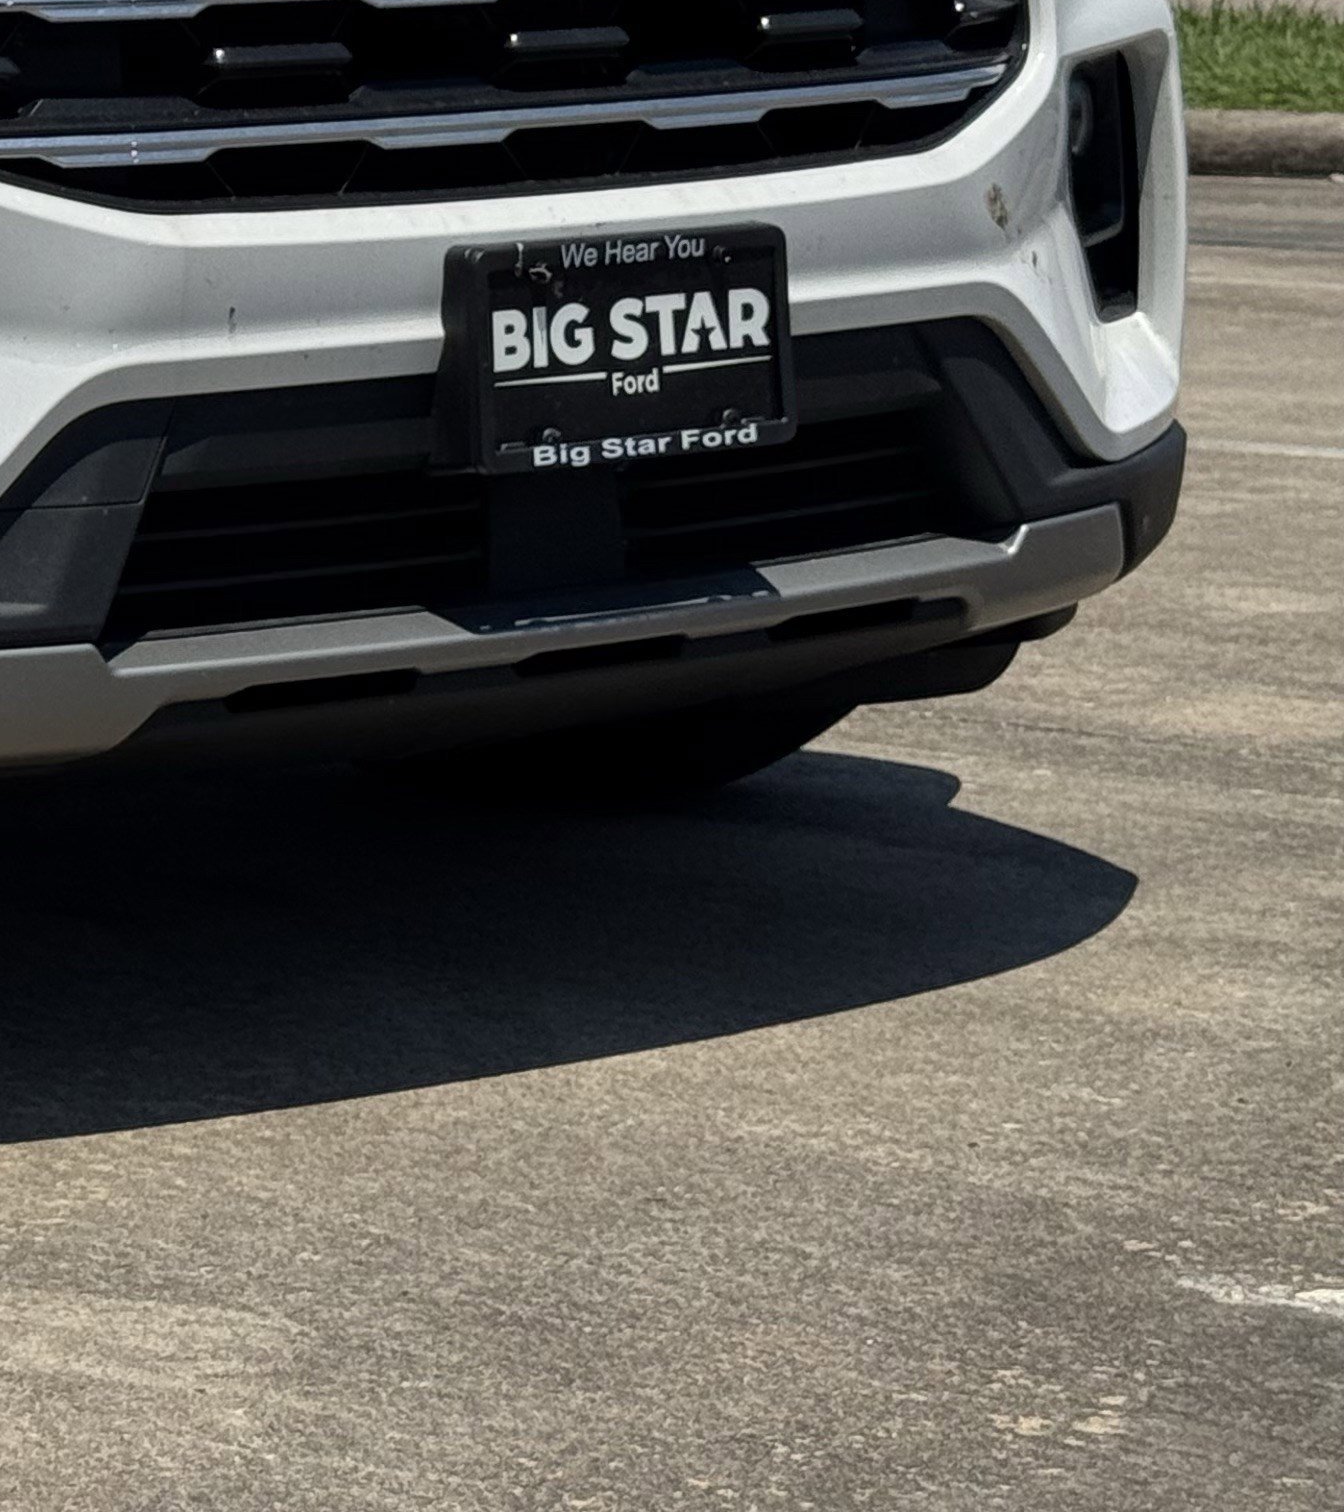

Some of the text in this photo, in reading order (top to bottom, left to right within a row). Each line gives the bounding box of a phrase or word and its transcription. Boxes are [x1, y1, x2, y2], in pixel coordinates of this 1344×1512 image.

[562, 235, 705, 269] We Hear You
[492, 288, 770, 373] BIG STAR
[611, 368, 660, 396] Ford
[533, 423, 758, 467] Big Star Ford
